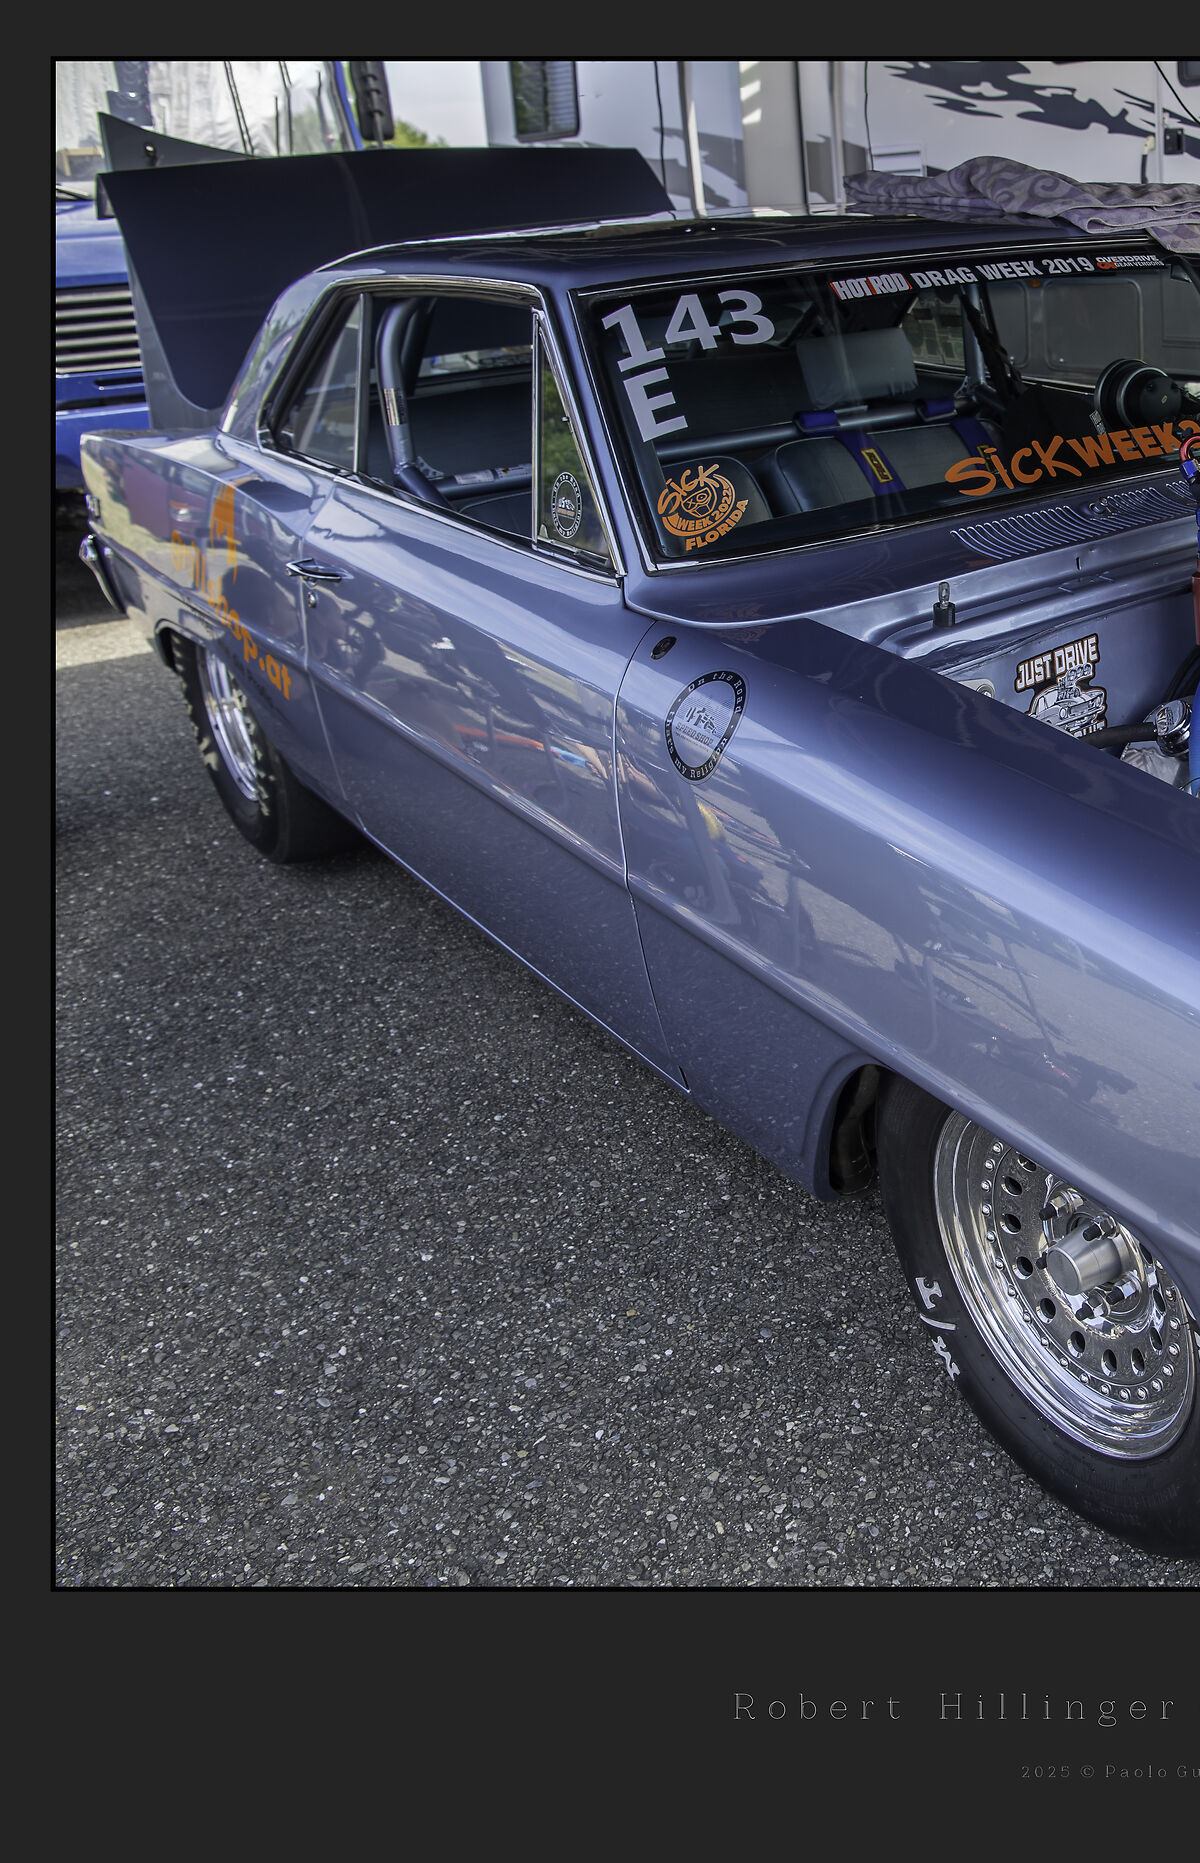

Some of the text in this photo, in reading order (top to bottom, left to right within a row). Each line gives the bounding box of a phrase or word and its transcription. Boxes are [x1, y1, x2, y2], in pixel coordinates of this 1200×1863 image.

[832, 256, 1095, 300] HOT ROD DRAG WEEK 2019
[601, 289, 775, 374] 143
[623, 366, 688, 442] E
[945, 434, 1082, 496] SICK
[1065, 421, 1182, 468] WEEK
[657, 463, 720, 515] SICK
[677, 487, 732, 532] WEEK 2022
[686, 499, 749, 552] FLORIDA
[1016, 636, 1099, 690] JUST DRIVE
[712, 671, 734, 681] the
[734, 679, 744, 714] Road
